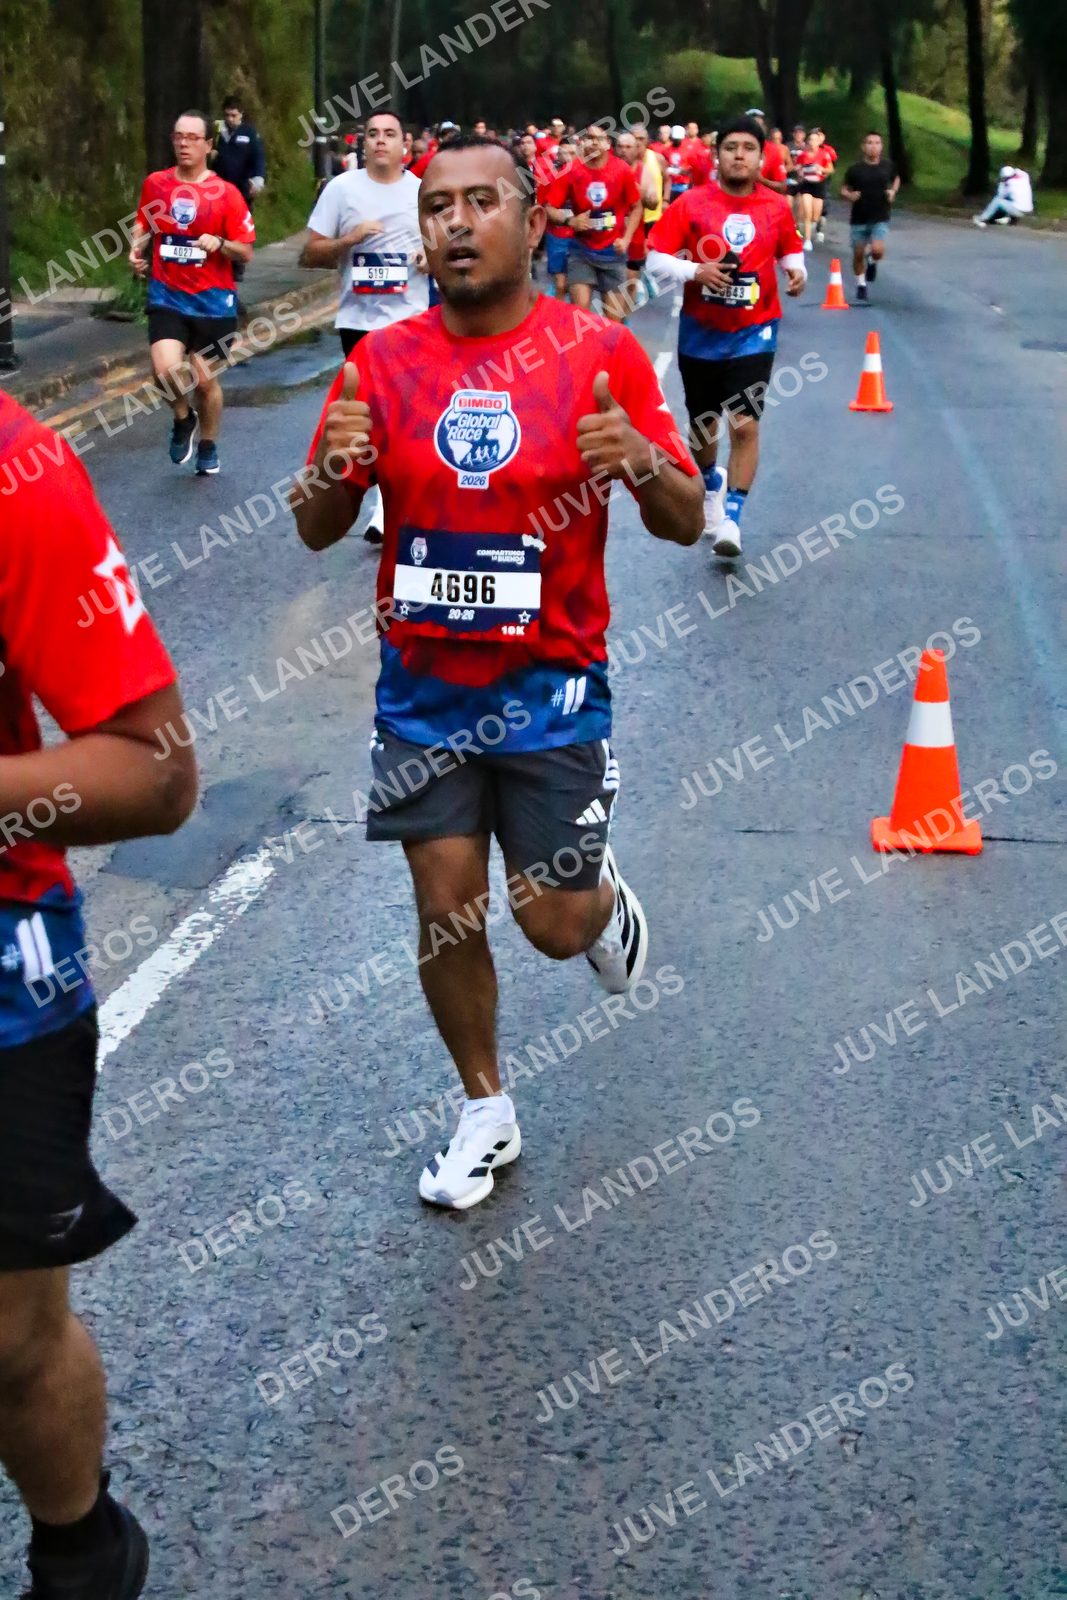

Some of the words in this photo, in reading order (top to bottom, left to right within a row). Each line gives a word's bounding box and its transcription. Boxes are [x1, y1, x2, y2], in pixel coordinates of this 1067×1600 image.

[173, 247, 193, 257] 4027
[368, 267, 390, 279] 5197
[458, 398, 503, 409] BIMBO
[457, 412, 501, 430] Global
[447, 425, 483, 441] Race
[460, 474, 487, 486] 2026
[430, 572, 497, 604] 4696
[501, 625, 526, 636] 10K
